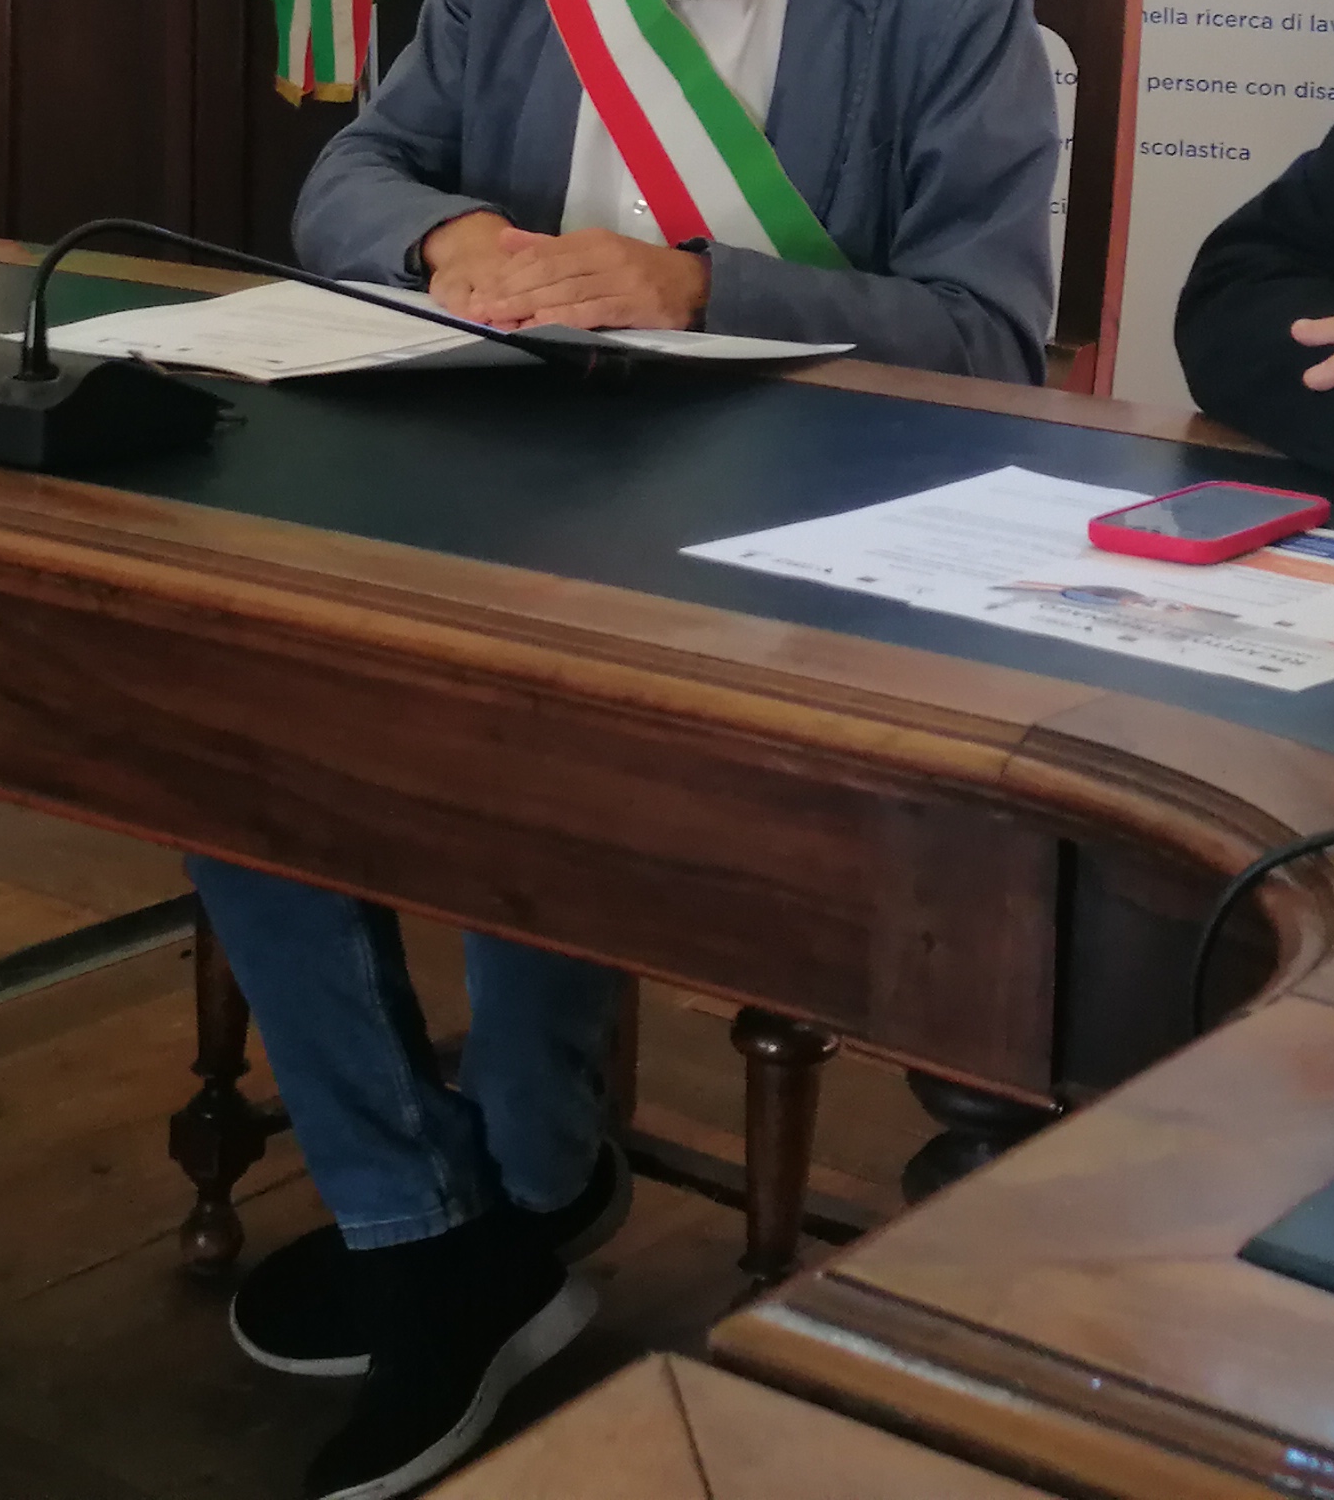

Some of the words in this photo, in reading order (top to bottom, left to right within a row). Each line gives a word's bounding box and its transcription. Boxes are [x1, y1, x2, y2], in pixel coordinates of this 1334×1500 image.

[1196, 8, 1272, 30] ricerca
[1281, 13, 1302, 31] di
[1147, 75, 1237, 94] persone
[1245, 80, 1286, 97] con
[1140, 139, 1252, 161] scolastica
